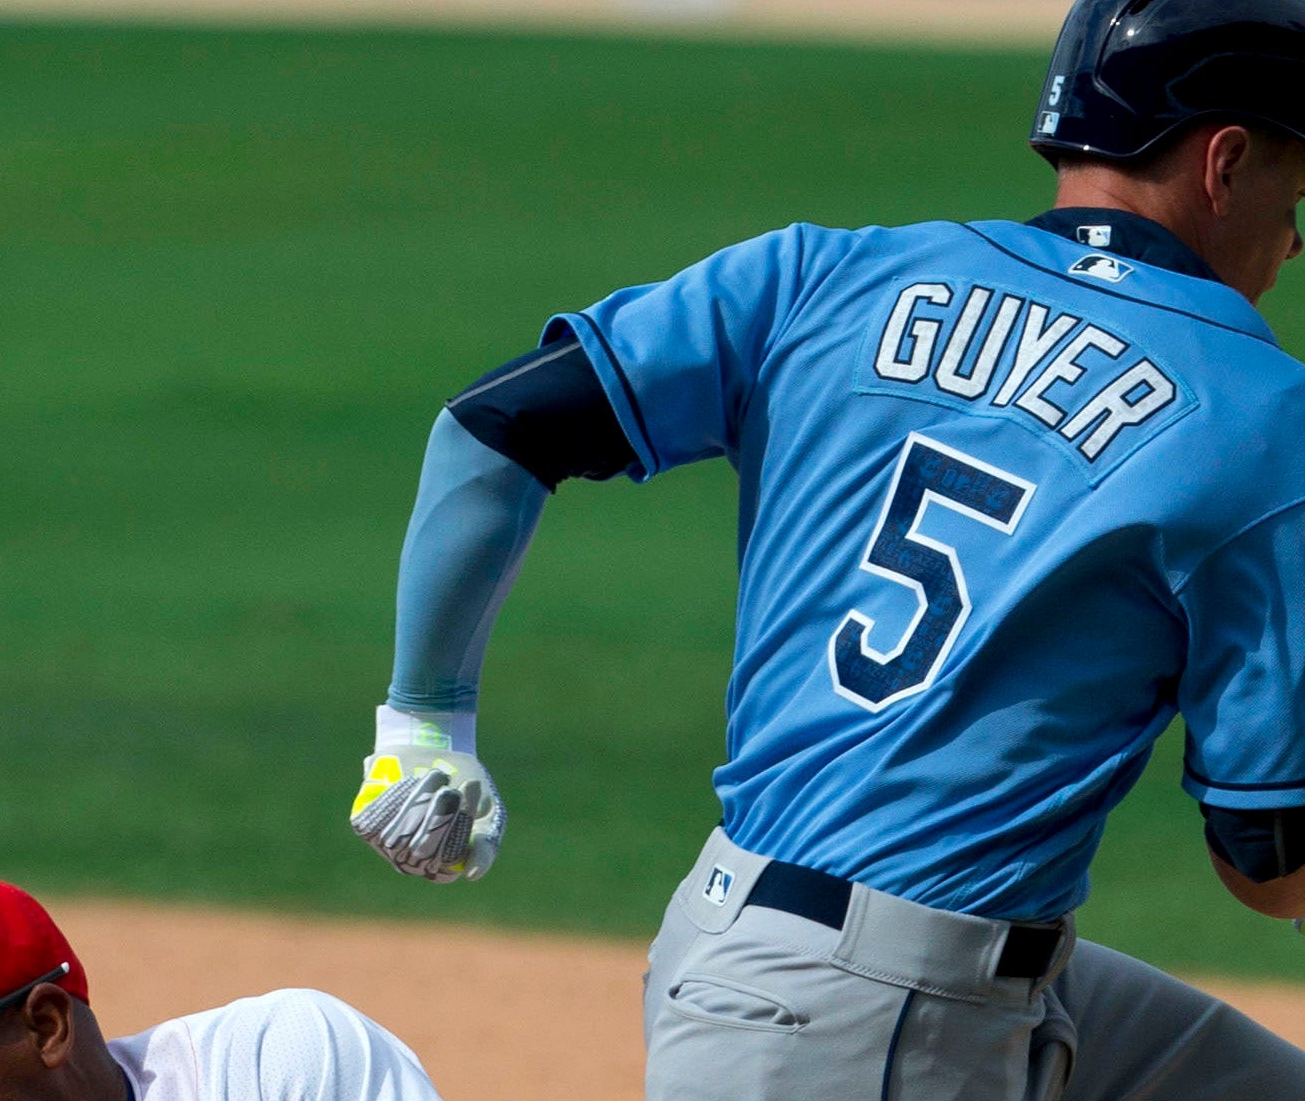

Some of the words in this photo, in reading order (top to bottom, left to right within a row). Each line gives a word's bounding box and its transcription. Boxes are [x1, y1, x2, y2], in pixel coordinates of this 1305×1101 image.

[1049, 75, 1065, 106] 5
[873, 281, 1177, 464] GUYER
[827, 431, 1037, 714] 5
